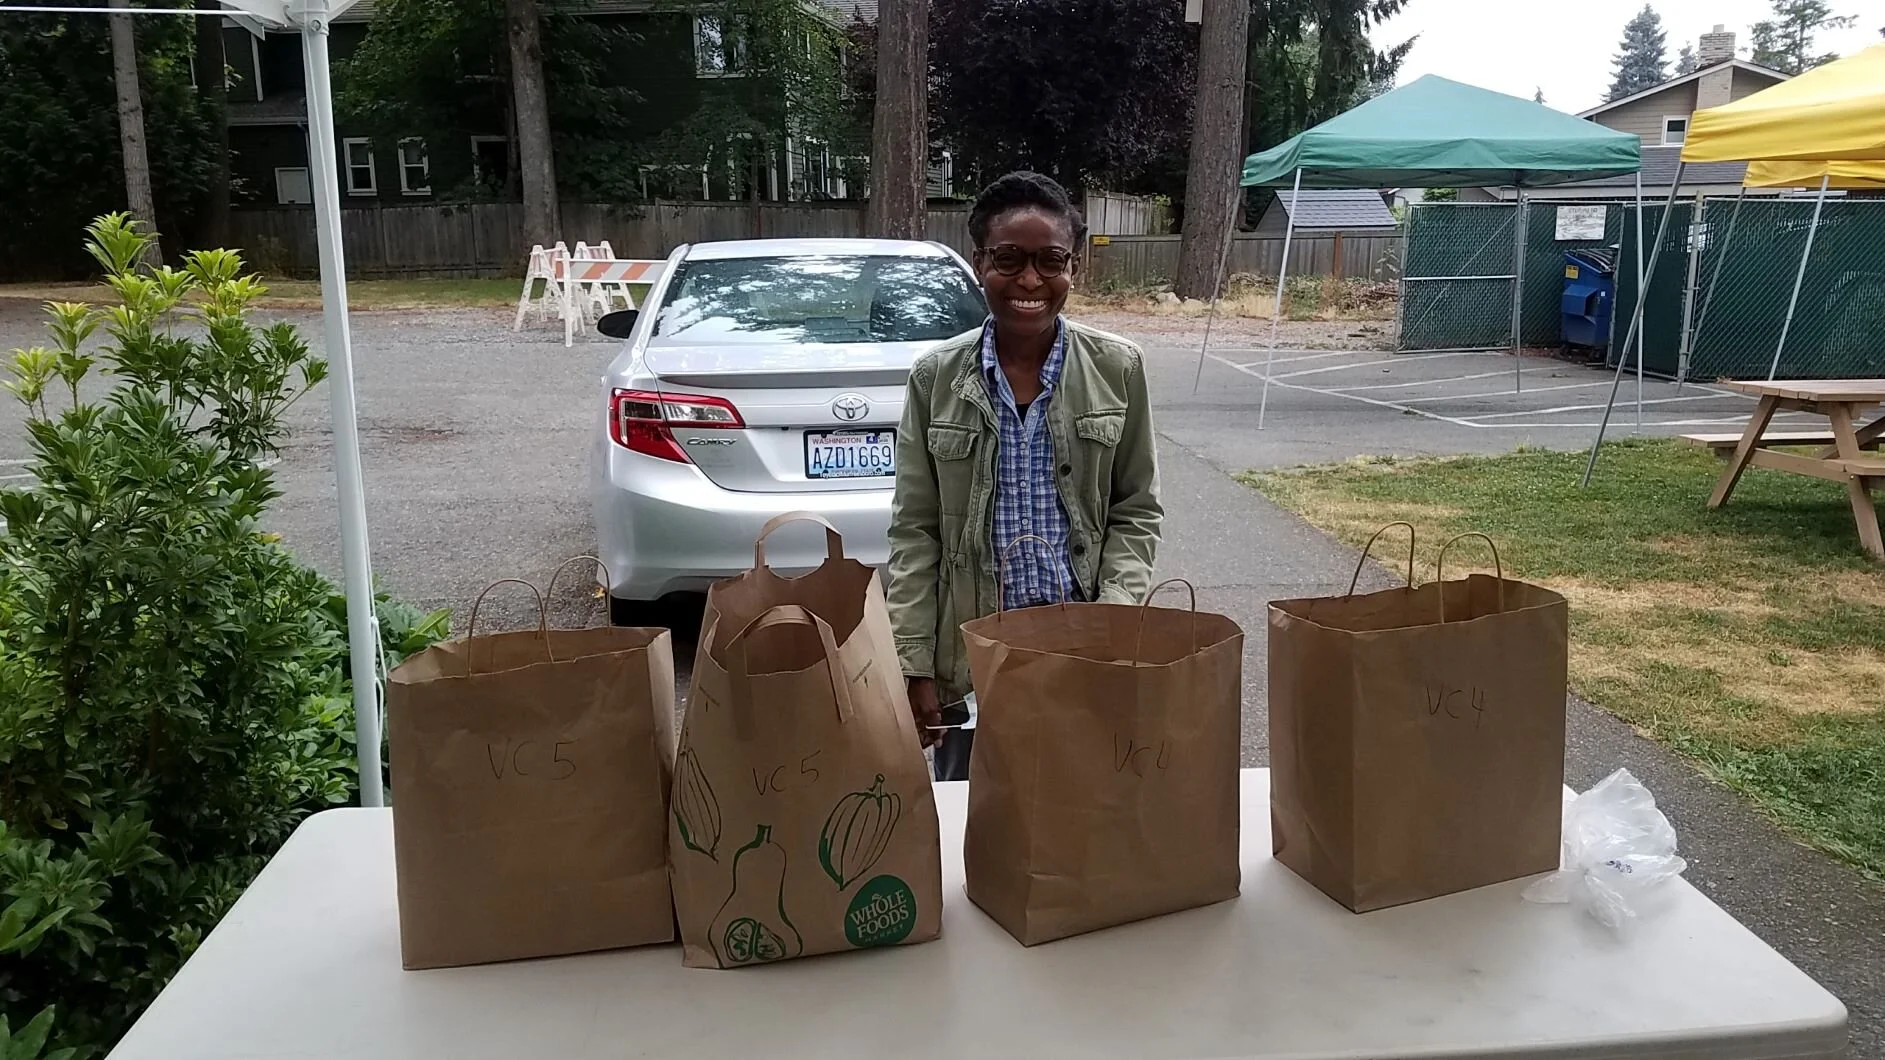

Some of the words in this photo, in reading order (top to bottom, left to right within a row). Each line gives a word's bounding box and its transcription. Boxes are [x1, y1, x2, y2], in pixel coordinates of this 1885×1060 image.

[812, 437, 861, 445] WASHINGTON
[813, 445, 892, 469] AZD1669
[488, 739, 534, 780] VC
[551, 738, 581, 780] 5
[752, 765, 785, 796] VC
[799, 749, 822, 785] 5
[849, 889, 907, 926] WHOLE
[856, 904, 909, 938] FOODS
